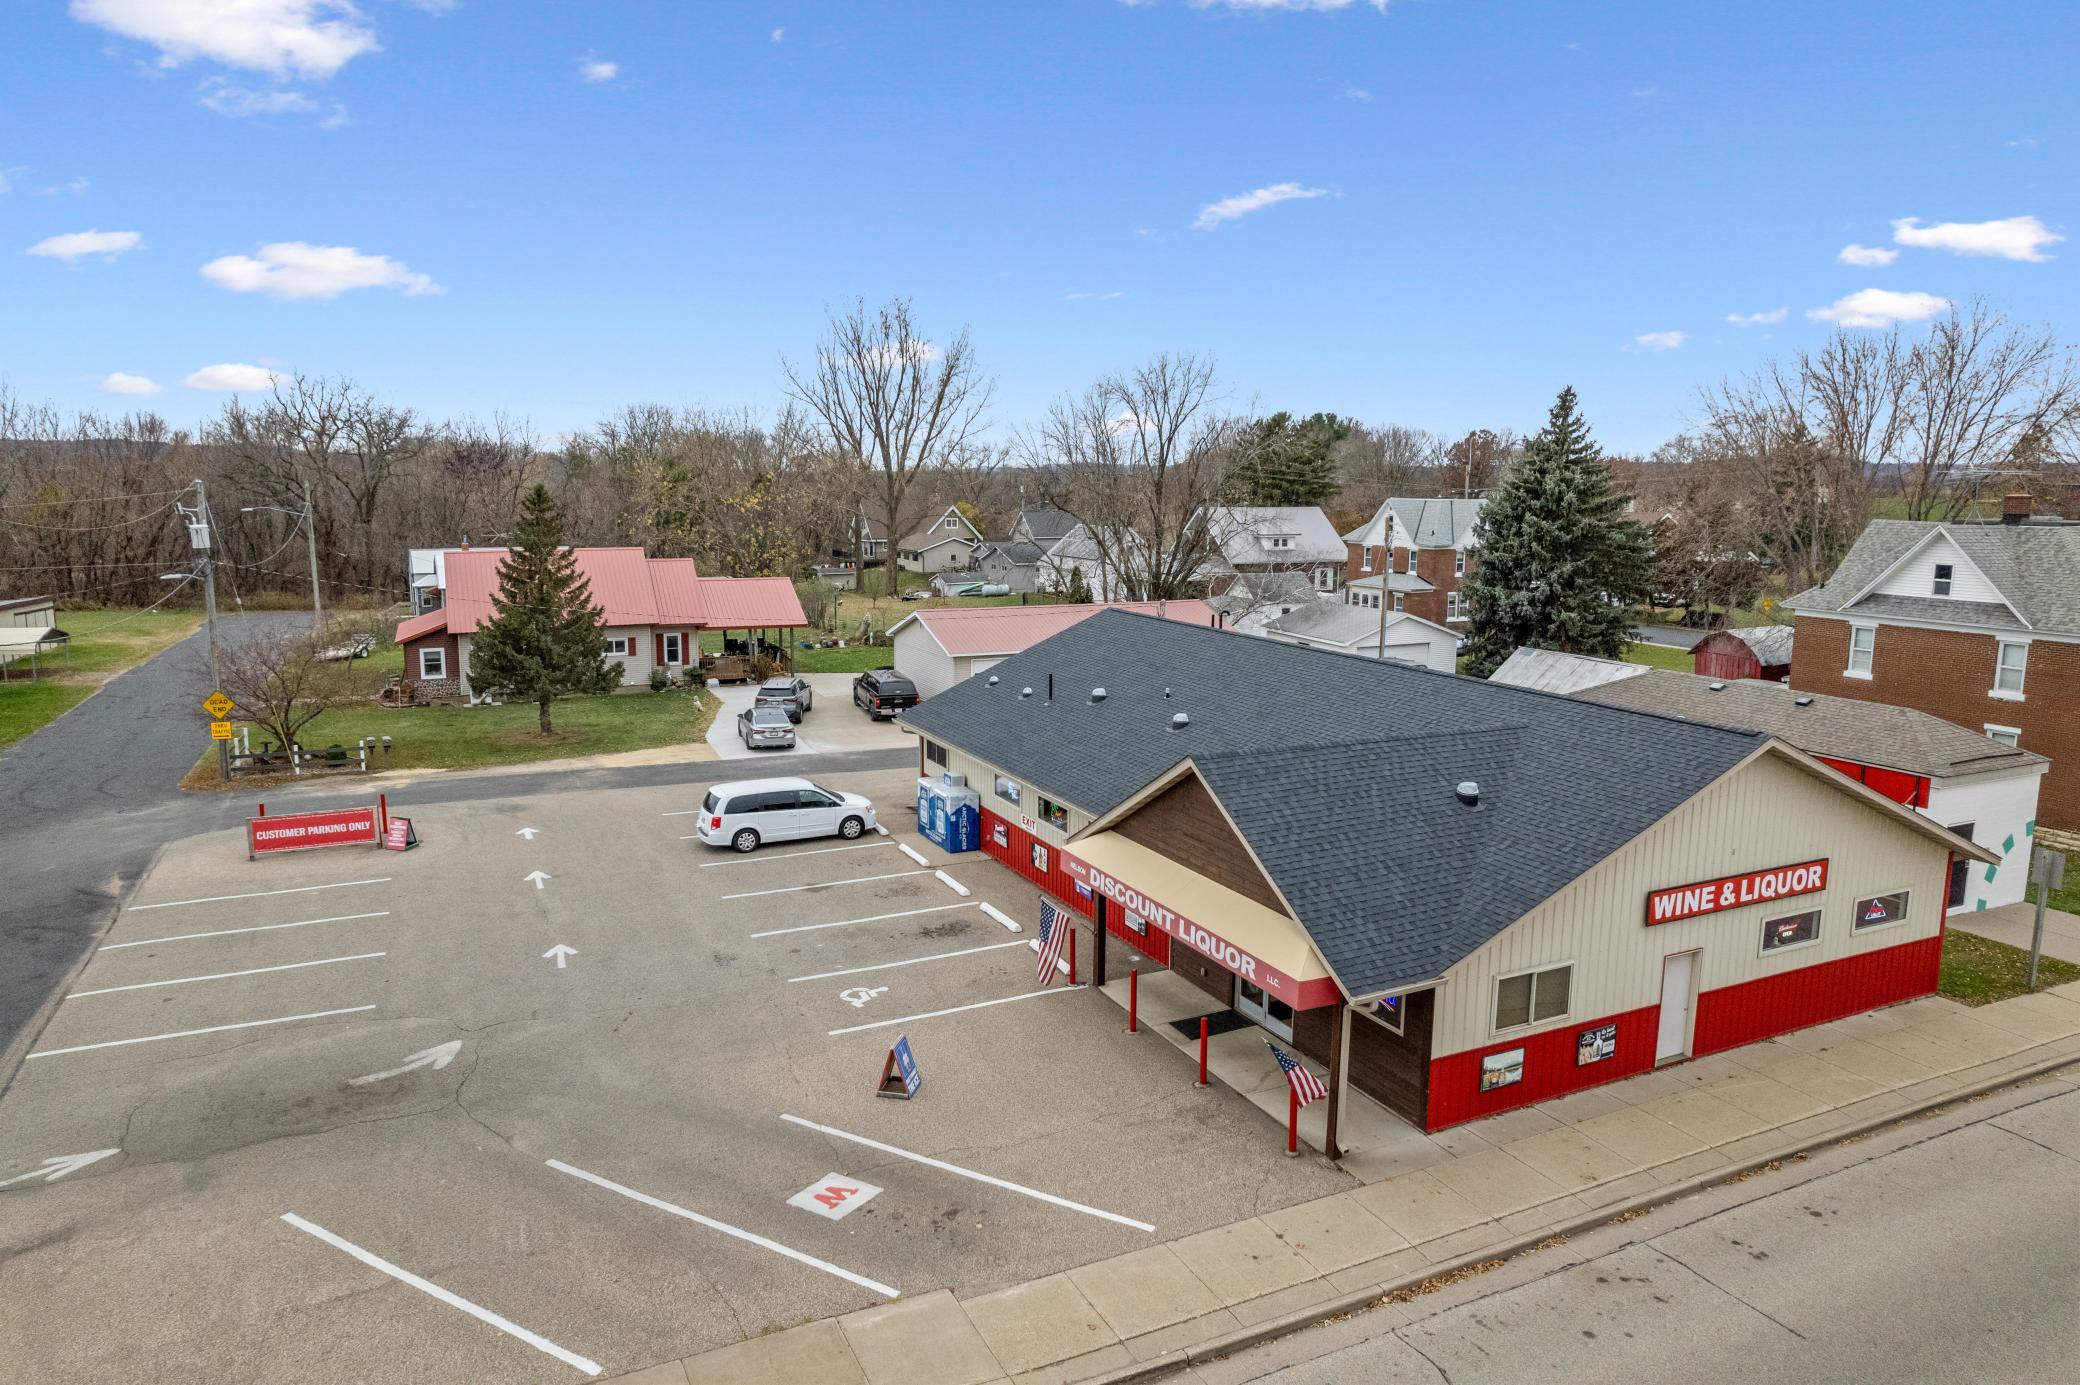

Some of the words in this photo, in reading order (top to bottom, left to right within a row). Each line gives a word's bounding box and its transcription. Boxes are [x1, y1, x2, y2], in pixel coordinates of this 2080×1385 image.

[210, 698, 229, 706] DEAD
[256, 826, 306, 840] CUSTOMER
[307, 824, 347, 836] PARKING
[348, 820, 371, 832] ONLY
[1021, 815, 1036, 830] EXIT
[1654, 885, 1716, 920] WINE
[1719, 882, 1736, 907] &
[1739, 865, 1822, 902] LIQUOR
[1089, 867, 1175, 931] DISCOUNT
[1178, 918, 1256, 981] LIQUOR
